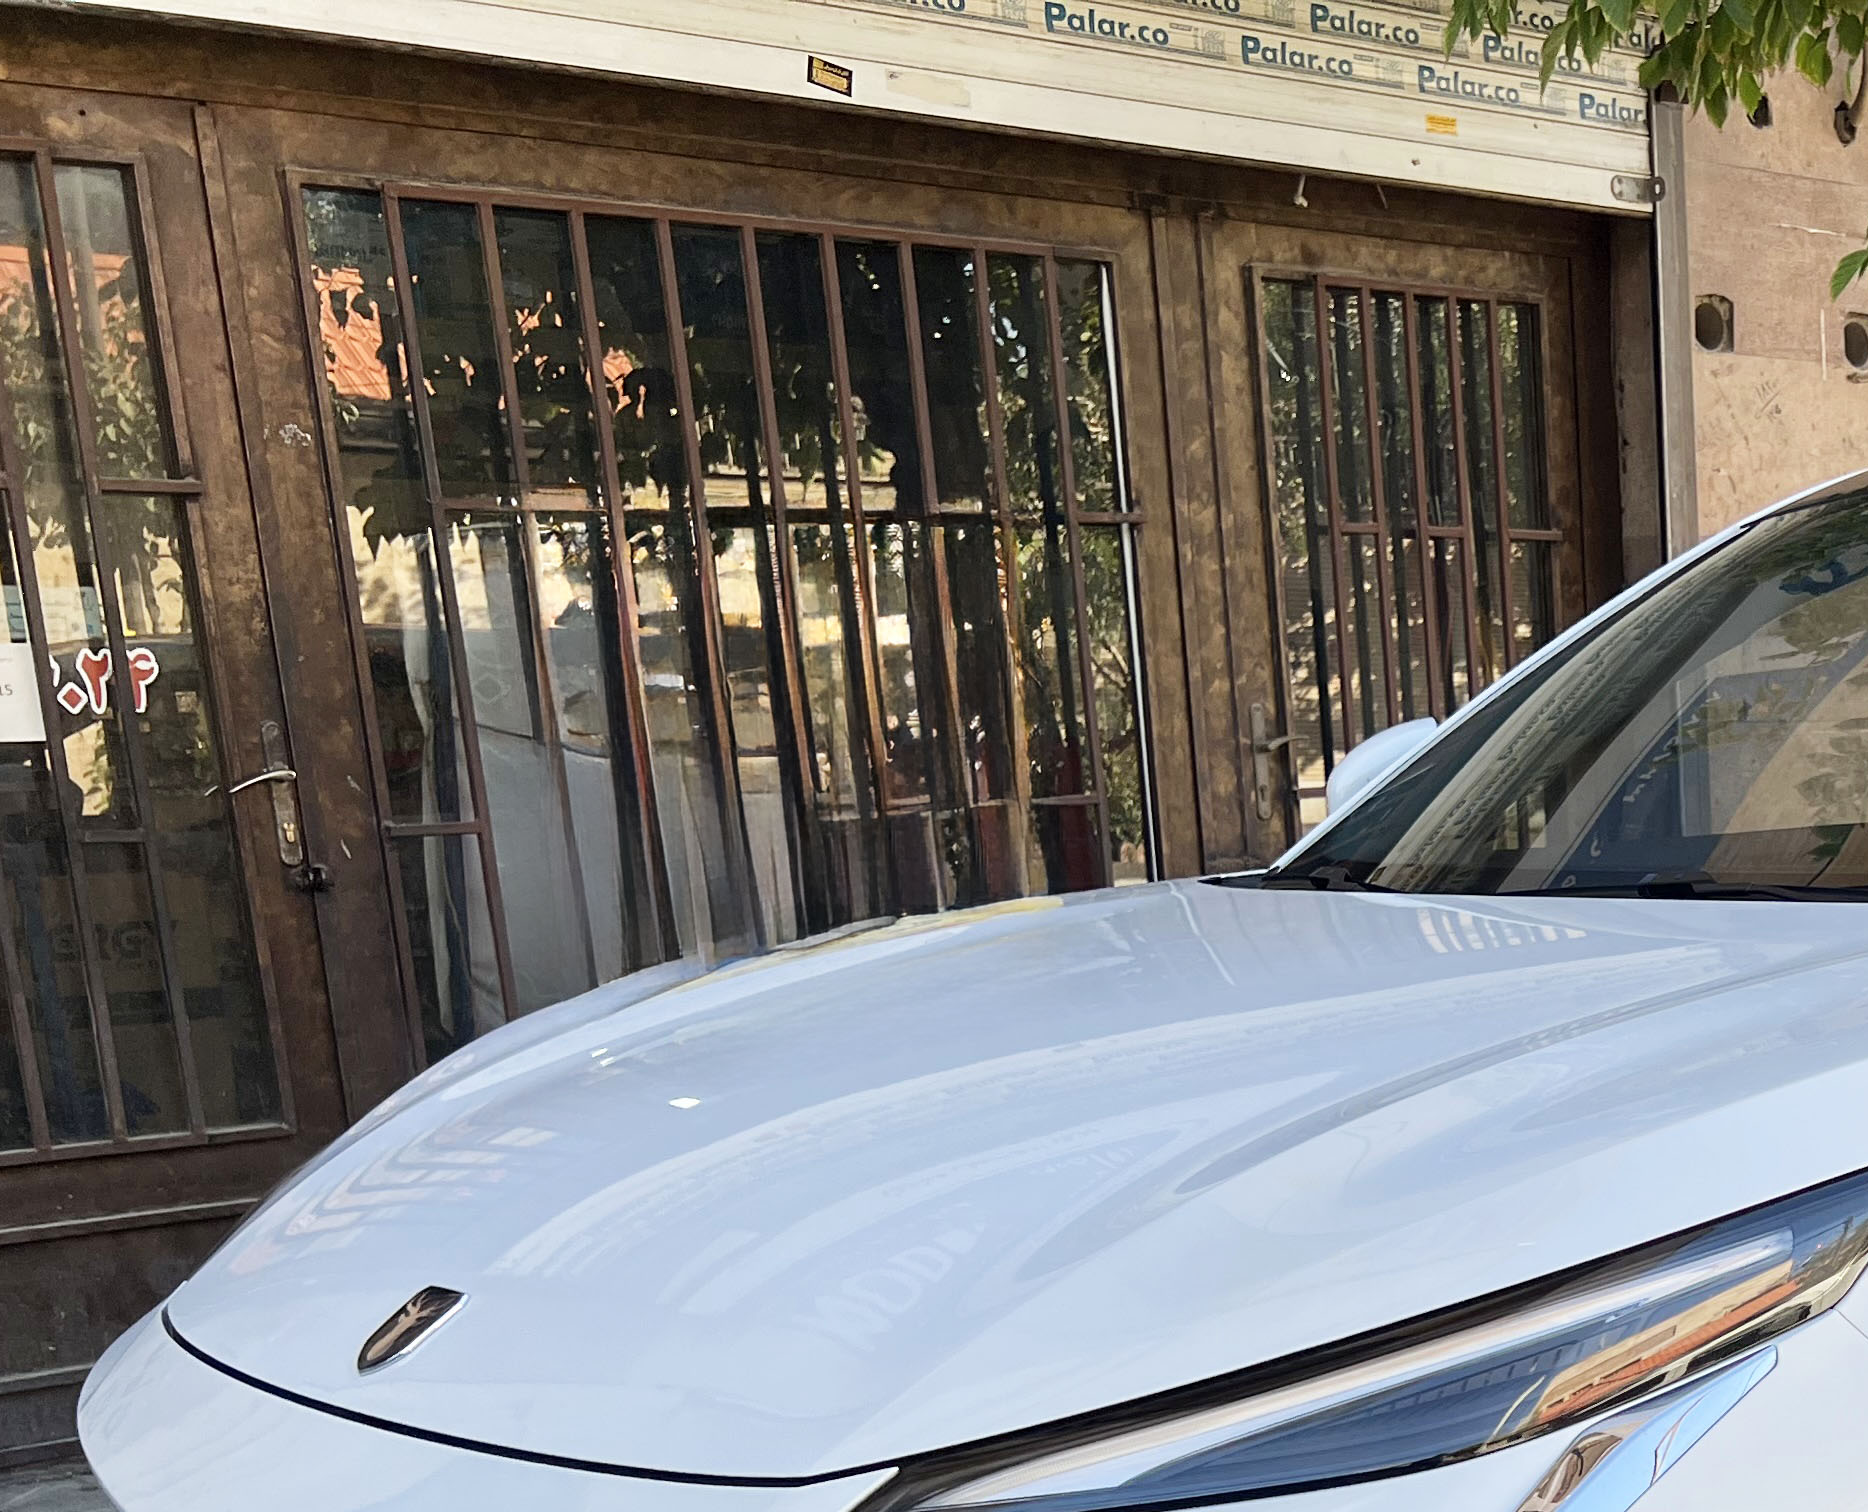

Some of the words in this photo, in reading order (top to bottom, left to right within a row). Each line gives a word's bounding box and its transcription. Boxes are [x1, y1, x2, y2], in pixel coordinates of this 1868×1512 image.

[1044, 1, 1169, 46] Palar.co
[1310, 3, 1420, 45] Palar.co
[1241, 35, 1353, 76] Palar.co
[1418, 65, 1520, 103] Palar.co
